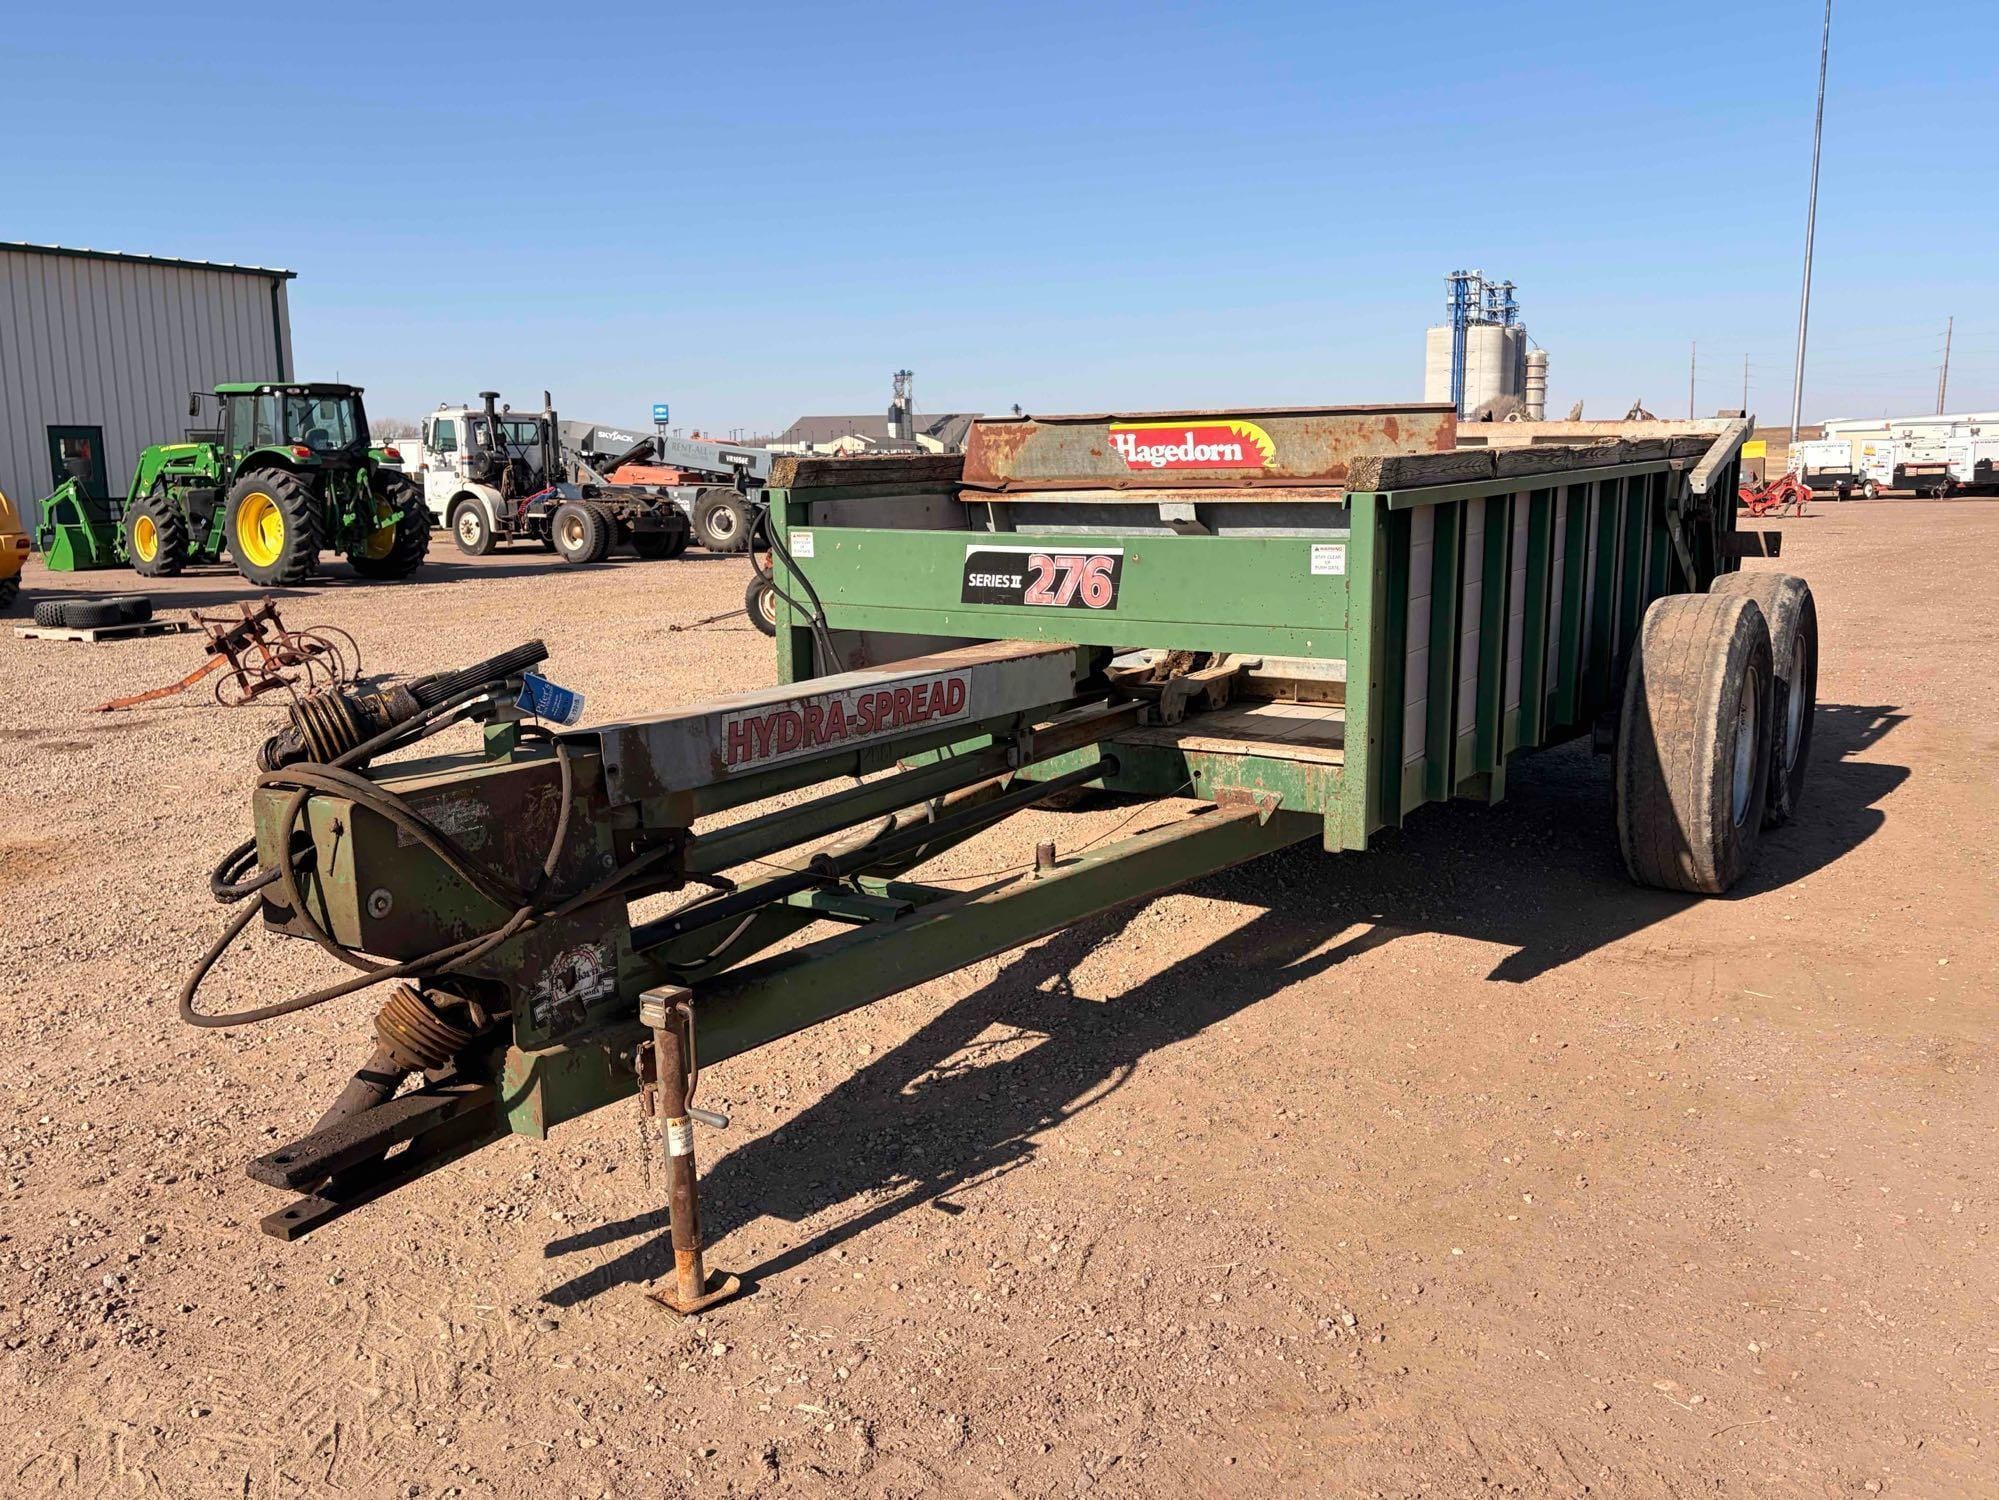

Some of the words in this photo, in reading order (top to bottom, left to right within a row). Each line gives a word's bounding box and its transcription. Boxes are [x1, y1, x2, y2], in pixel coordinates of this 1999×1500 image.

[597, 431, 634, 442] SKYJACK
[1115, 432, 1243, 467] Hagedorn
[968, 573, 1010, 588] SERIES
[1024, 553, 1115, 608] 276
[727, 678, 967, 766] HYDRA-SPREAD
